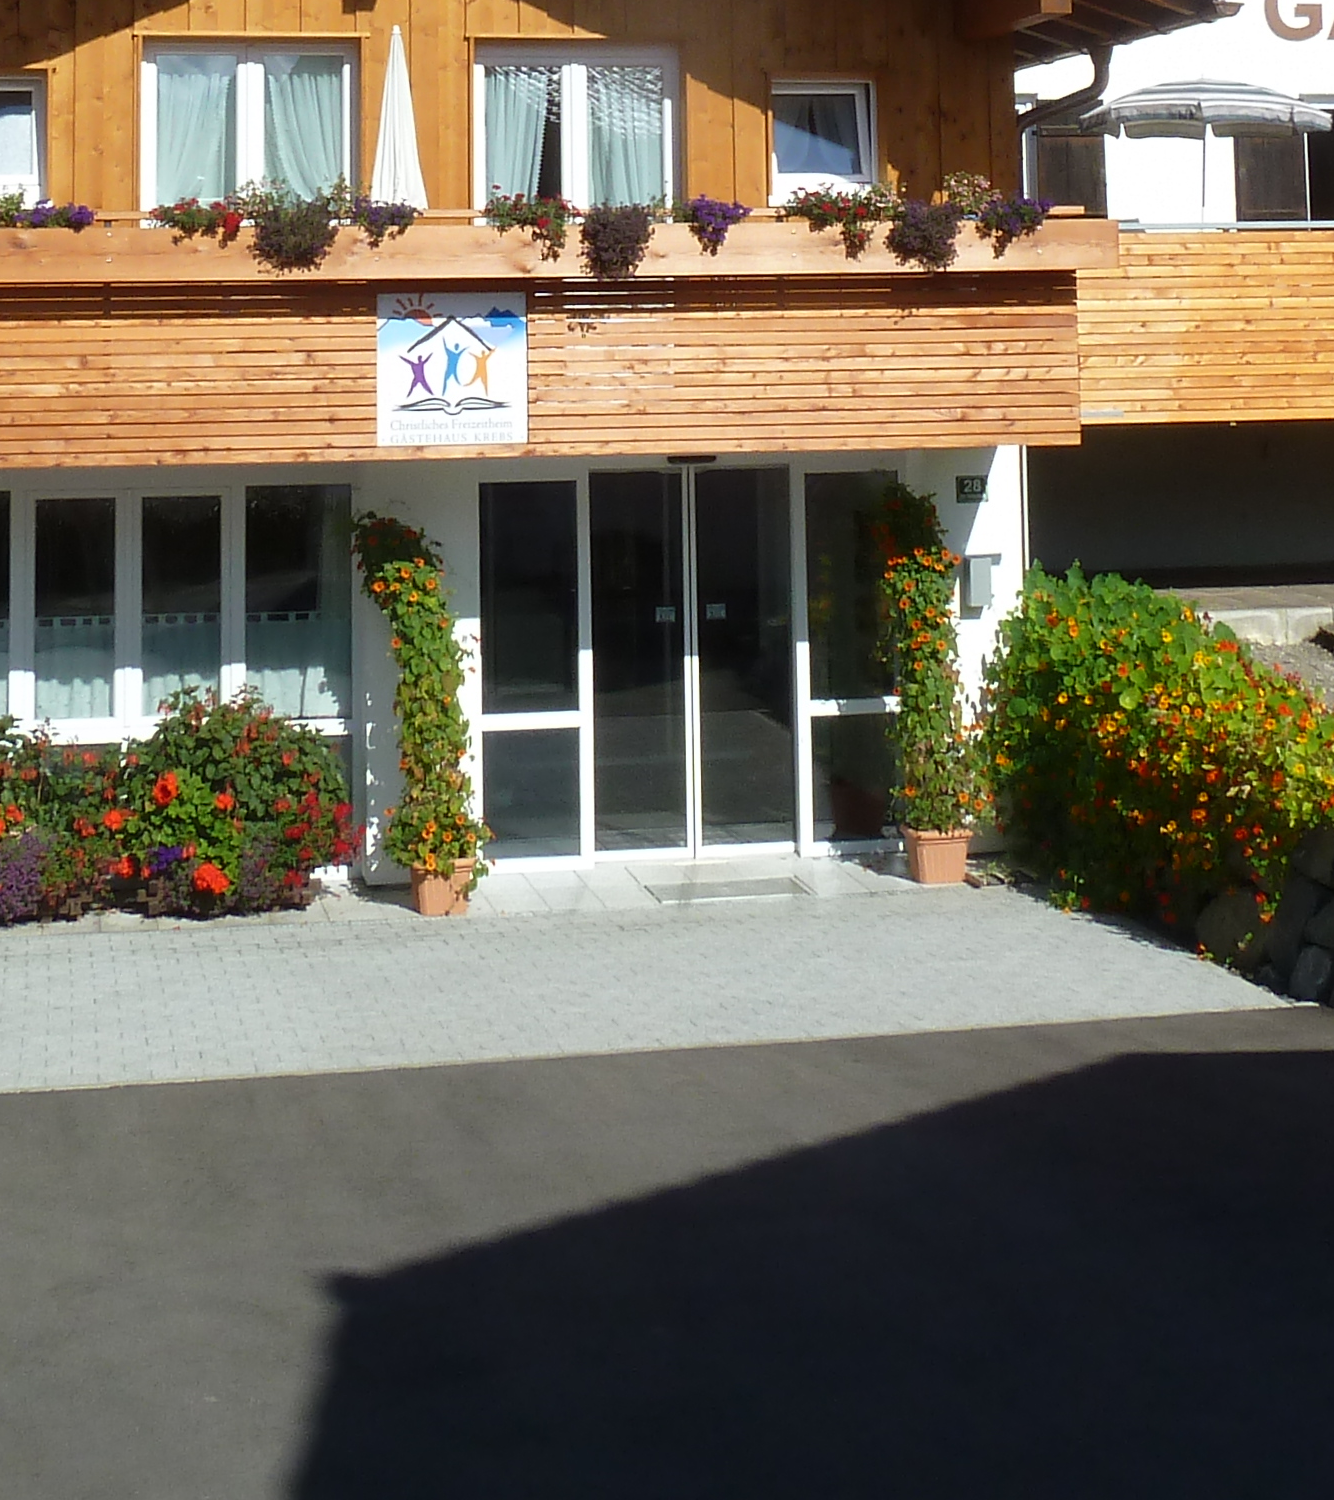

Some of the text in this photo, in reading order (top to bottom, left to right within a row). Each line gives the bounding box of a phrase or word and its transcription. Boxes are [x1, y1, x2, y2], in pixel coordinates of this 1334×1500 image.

[390, 417, 513, 431] Christliches Freizeitheim
[390, 431, 513, 444] GÄSTEHAUS KREBS
[963, 479, 982, 493] 28
